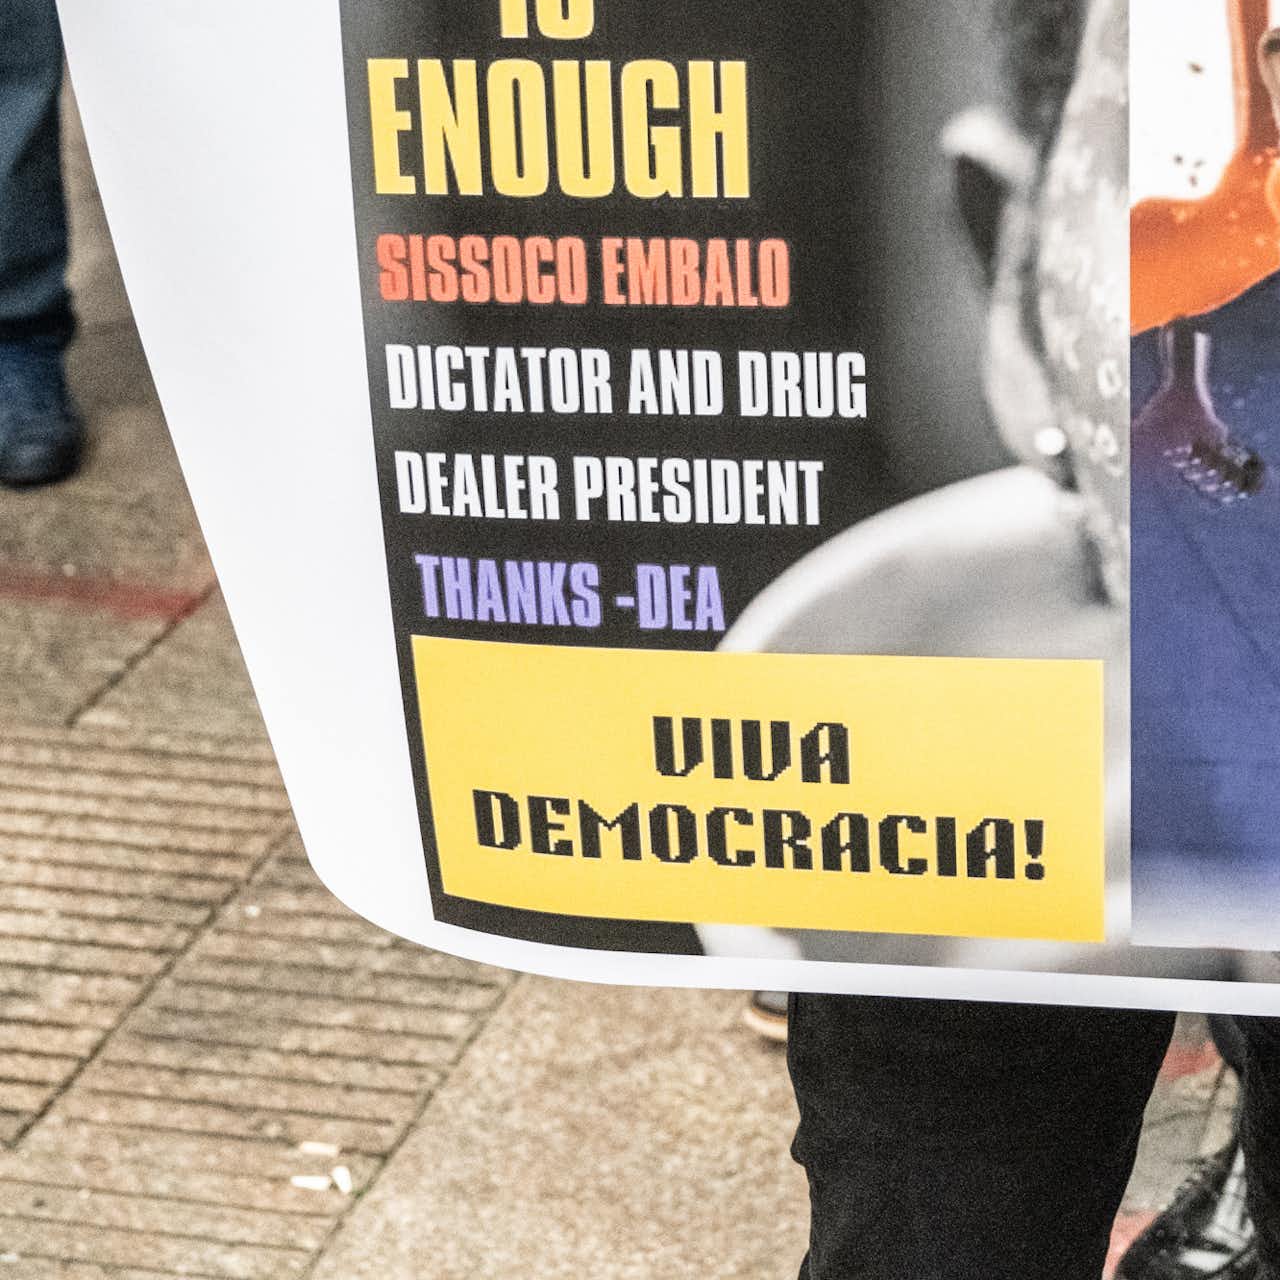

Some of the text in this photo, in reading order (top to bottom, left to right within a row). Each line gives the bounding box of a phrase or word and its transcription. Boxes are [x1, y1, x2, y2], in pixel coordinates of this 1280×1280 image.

[367, 58, 750, 199] ENOUGH
[377, 233, 790, 307] SISSOCO EMBALO
[385, 343, 867, 419] DICTATOR AND DRUG
[394, 450, 824, 526] DEALER PRESIDENT
[415, 553, 602, 628] THANKS
[652, 715, 851, 785] VIVA
[472, 789, 1046, 881] DEMOCRACIA!
